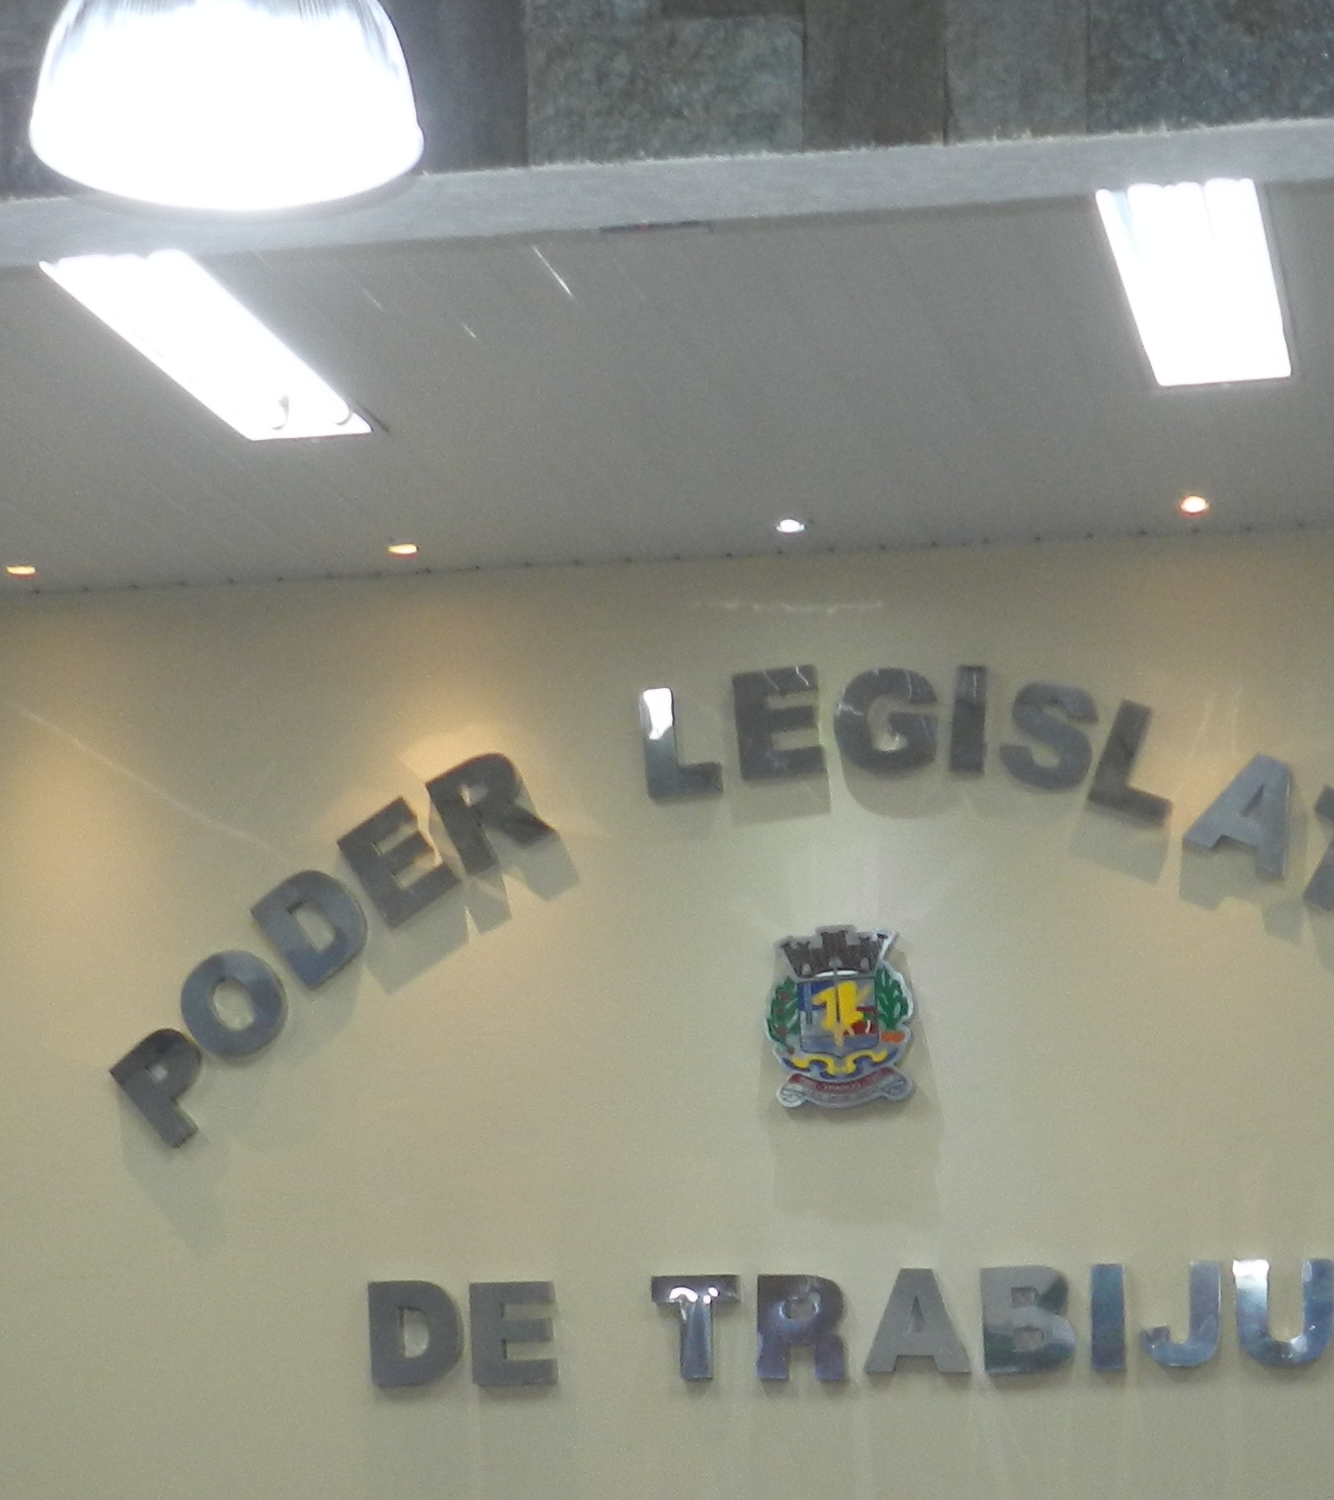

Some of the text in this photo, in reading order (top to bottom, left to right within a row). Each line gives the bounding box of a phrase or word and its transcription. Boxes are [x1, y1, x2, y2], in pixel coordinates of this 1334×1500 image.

[109, 751, 556, 1147] PODER
[368, 1259, 1334, 1387] DE TRABIJU
